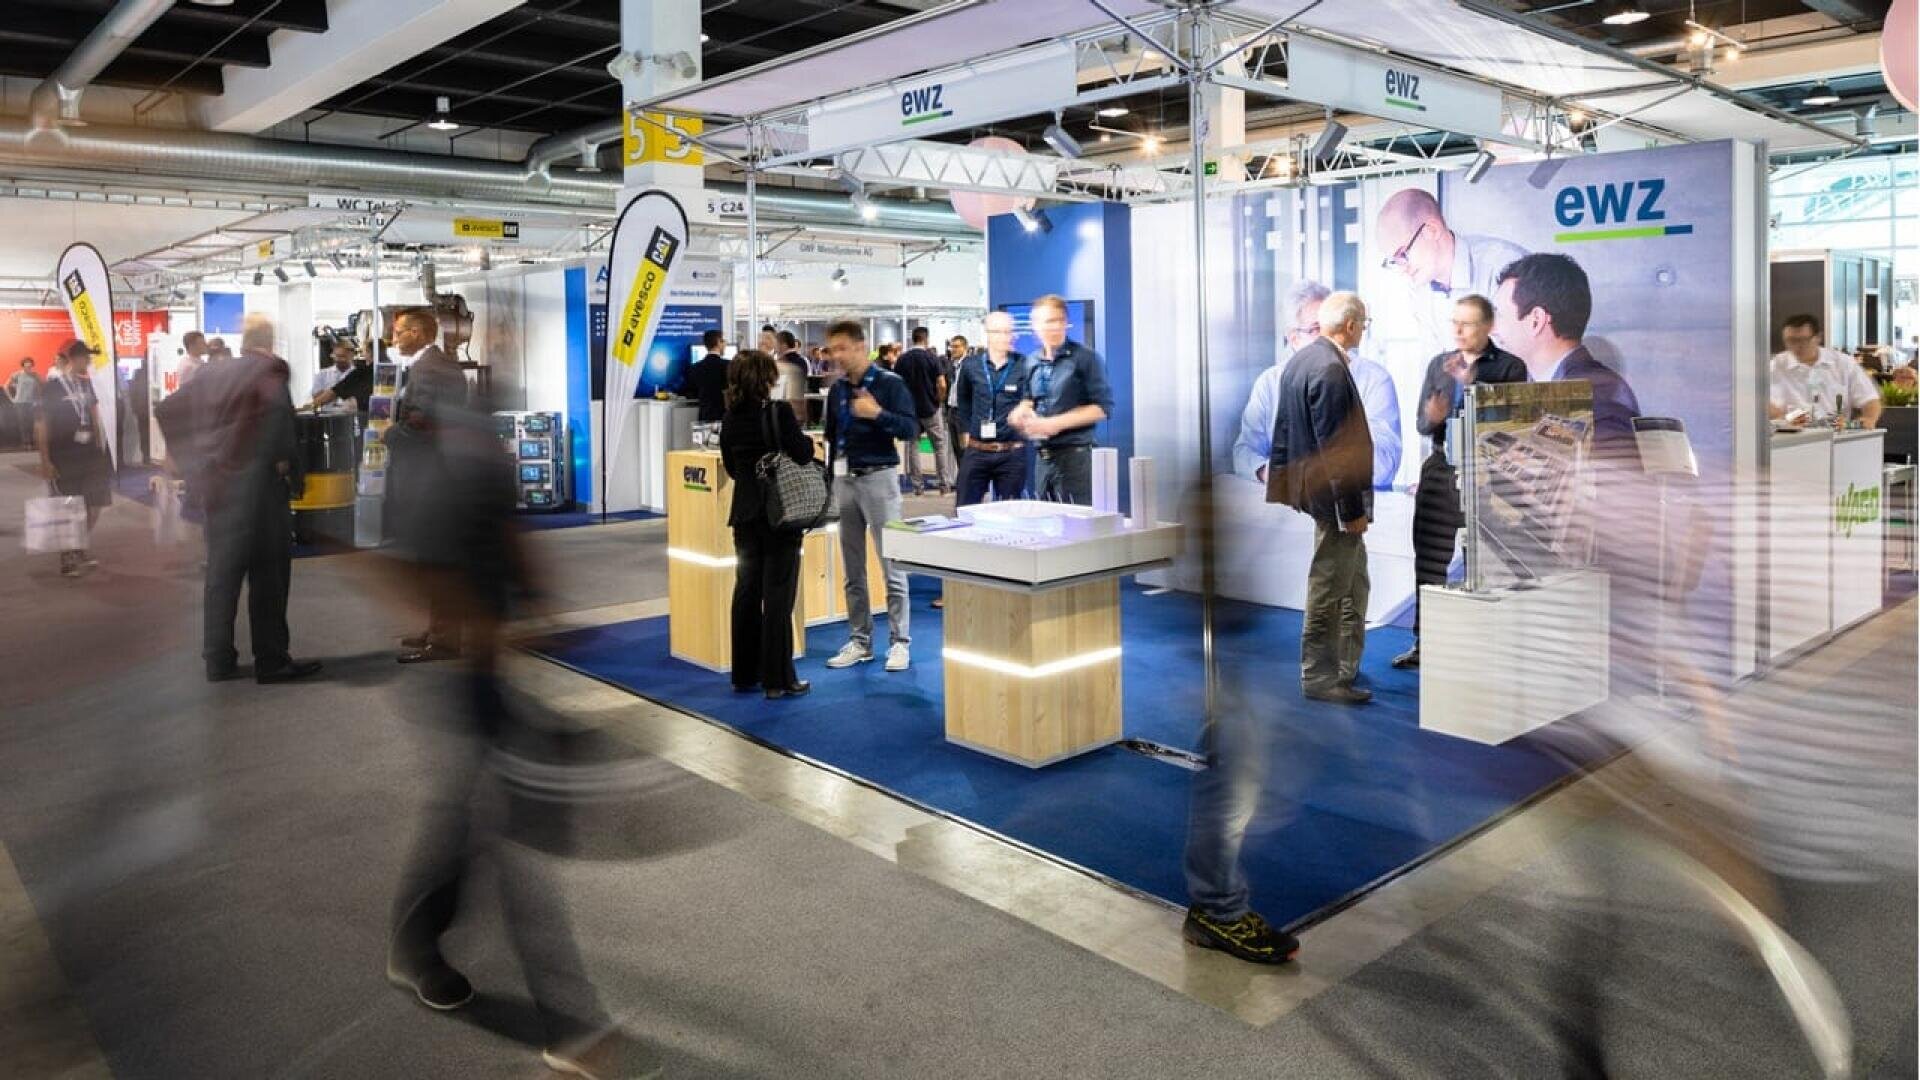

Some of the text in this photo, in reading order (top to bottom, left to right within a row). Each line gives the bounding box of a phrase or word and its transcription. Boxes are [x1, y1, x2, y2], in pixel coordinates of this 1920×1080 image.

[902, 84, 943, 115] ewz
[1386, 69, 1419, 100] ewz
[630, 113, 691, 160] 5 5
[707, 203, 715, 213] 5
[720, 202, 744, 213] C24
[1555, 178, 1665, 227] ewz
[630, 232, 672, 329] avesco CAT
[683, 465, 707, 484] ewz
